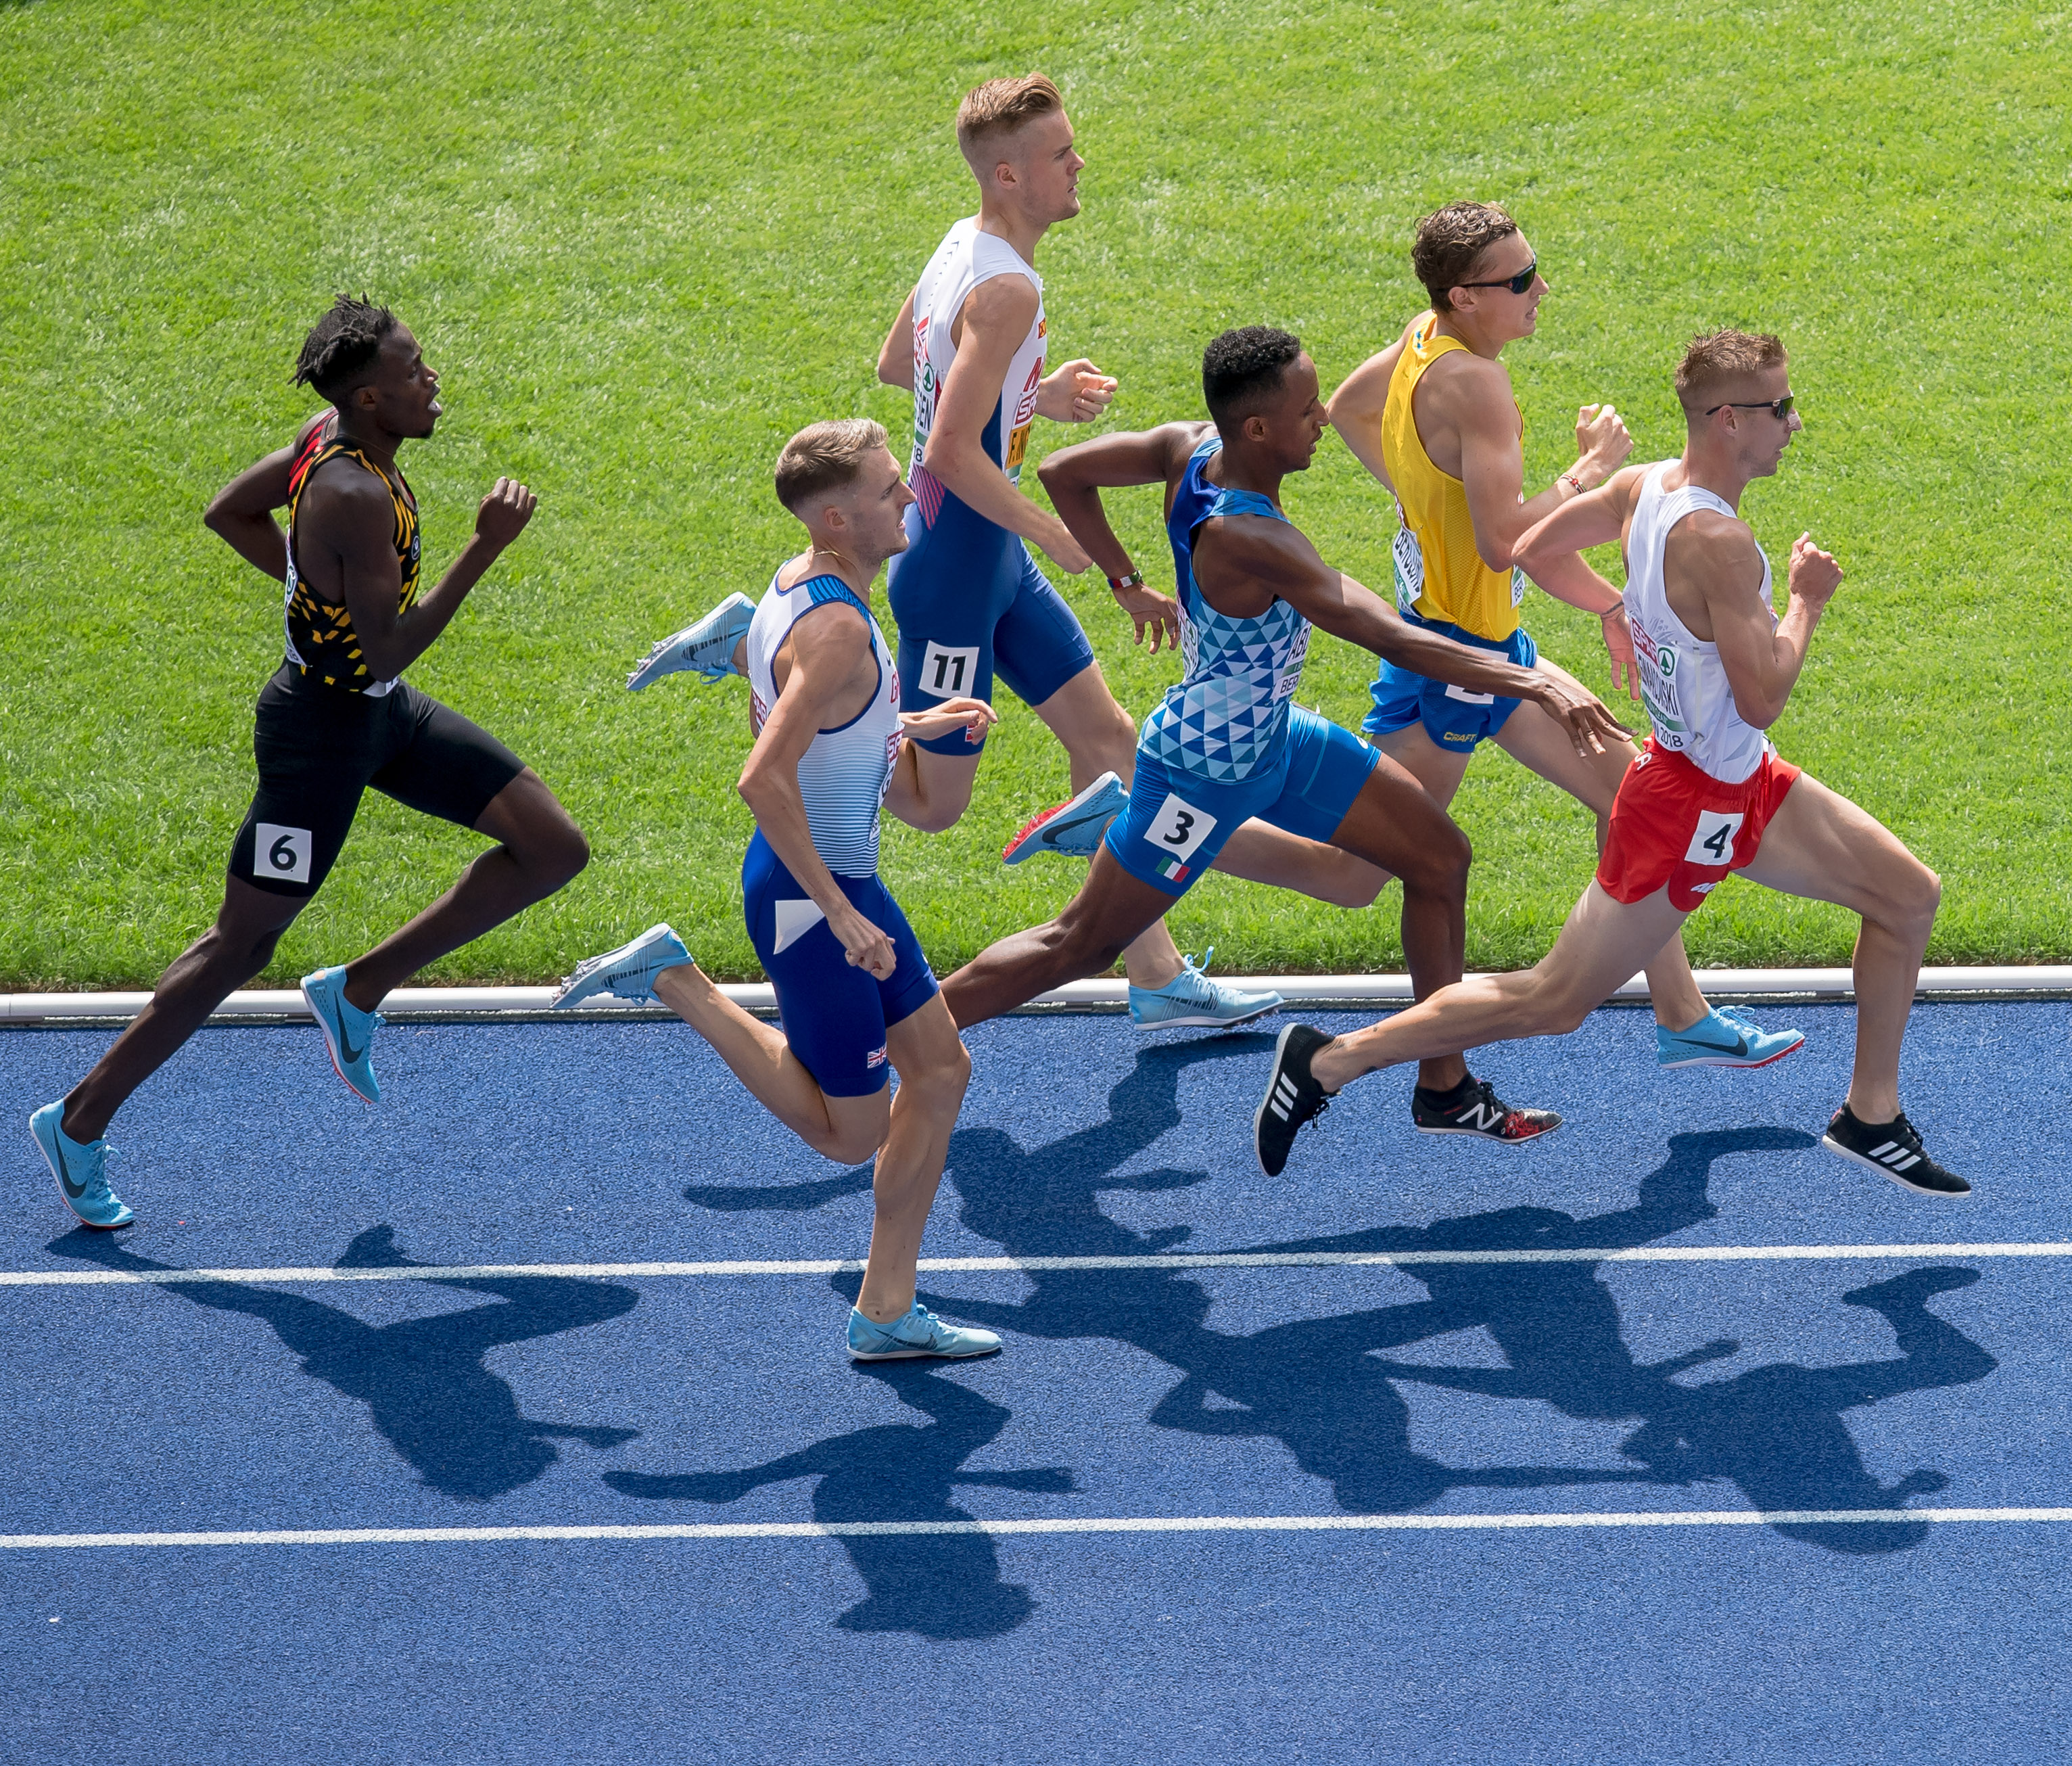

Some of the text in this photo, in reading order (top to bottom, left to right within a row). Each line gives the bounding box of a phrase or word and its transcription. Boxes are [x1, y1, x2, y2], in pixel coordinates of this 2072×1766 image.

[933, 653, 967, 691] 11
[1443, 731, 1478, 743] CRAFT
[1162, 810, 1195, 845] 3
[1703, 823, 1732, 859] 4
[269, 834, 296, 872] 6
